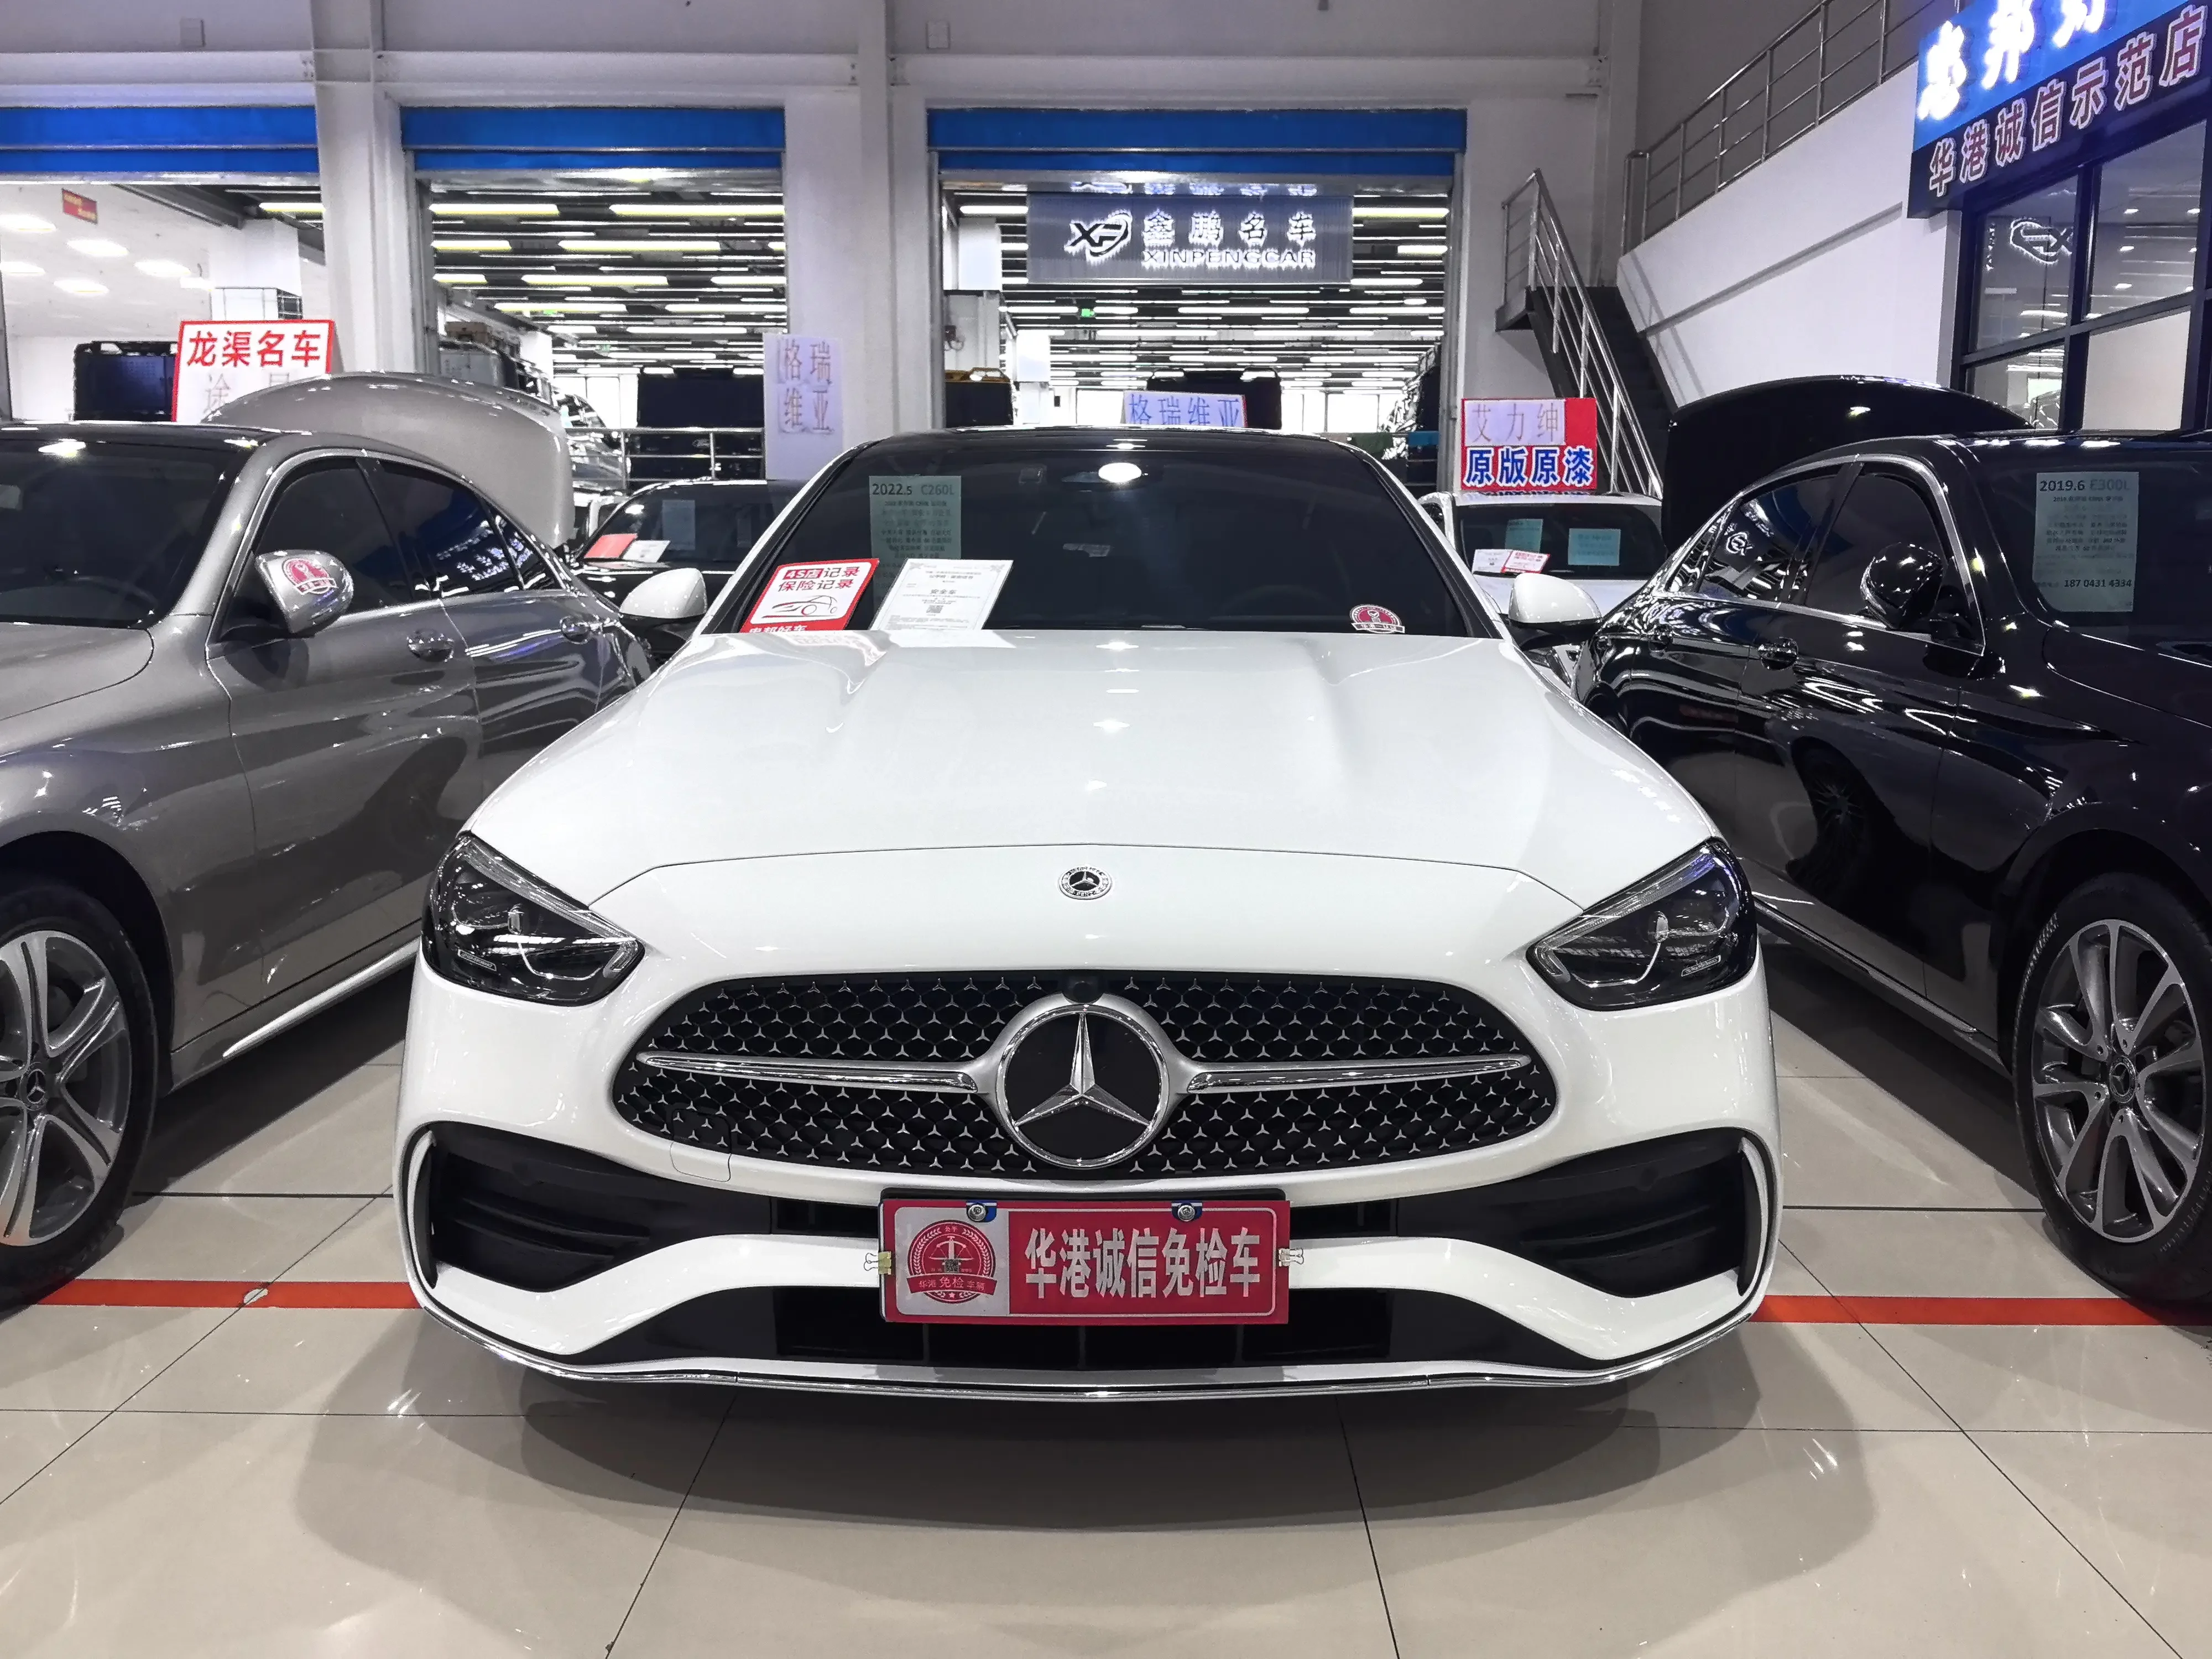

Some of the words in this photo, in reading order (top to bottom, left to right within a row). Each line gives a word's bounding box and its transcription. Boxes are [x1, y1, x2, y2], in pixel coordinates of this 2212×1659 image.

[1929, 4, 2207, 197] 华港诚信示范店
[1144, 210, 1316, 244] 鑫鹏名车
[1142, 249, 1315, 267] XINPENGCAR
[186, 330, 322, 367] 龙渠名车
[784, 338, 831, 382] 格瑞
[784, 387, 830, 431] 维亚
[1129, 394, 1239, 427] 格瑞维亚
[1472, 402, 1559, 443] 艾力绅
[1464, 446, 1595, 488] 原版原漆
[872, 483, 912, 495] 2022.5
[921, 484, 955, 495] C260L
[2039, 479, 2085, 492] 2019.6
[2090, 479, 2130, 491] E300L
[778, 579, 854, 592] 保险记录
[785, 566, 860, 580] 4S店记录
[2083, 579, 2106, 587] 0431
[1024, 1227, 1261, 1300] 华港诚信免检车
[939, 1276, 964, 1288] 免检
